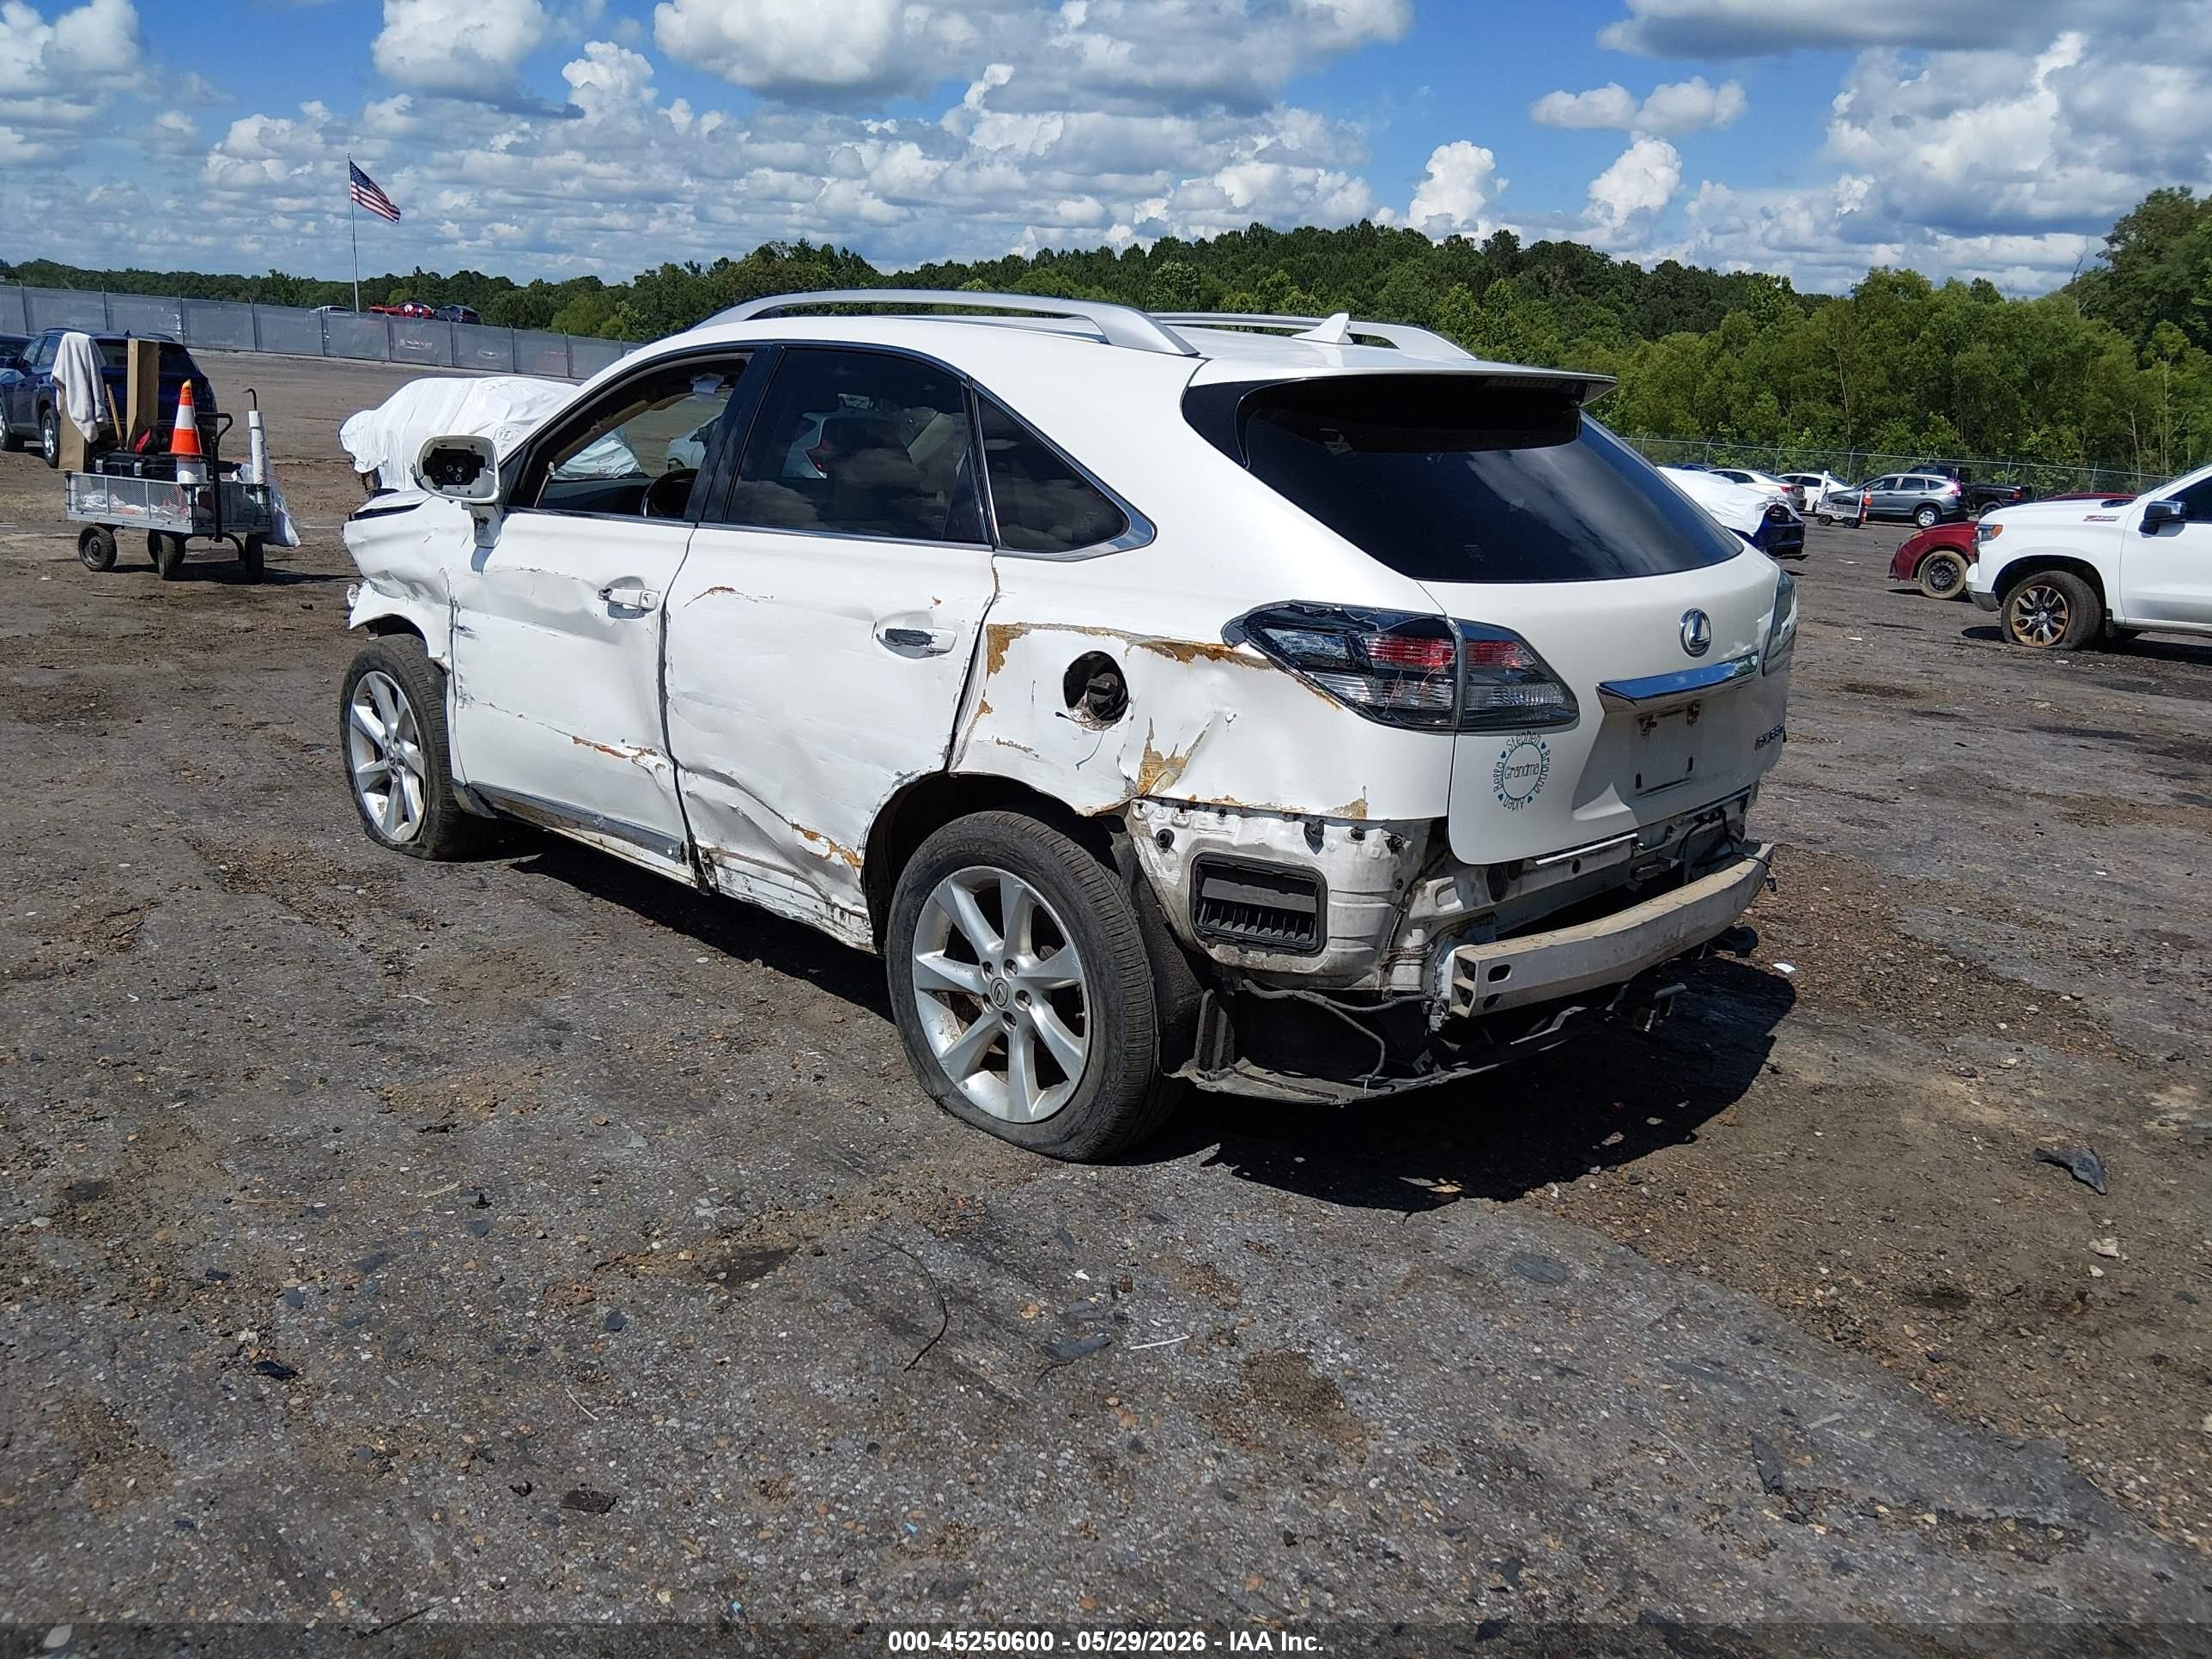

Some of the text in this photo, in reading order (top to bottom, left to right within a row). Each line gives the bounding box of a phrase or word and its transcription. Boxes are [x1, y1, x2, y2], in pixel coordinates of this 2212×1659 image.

[1506, 730, 1541, 752] Stephen
[1504, 763, 1540, 780] Grandma
[1533, 749, 1551, 793] Brianna
